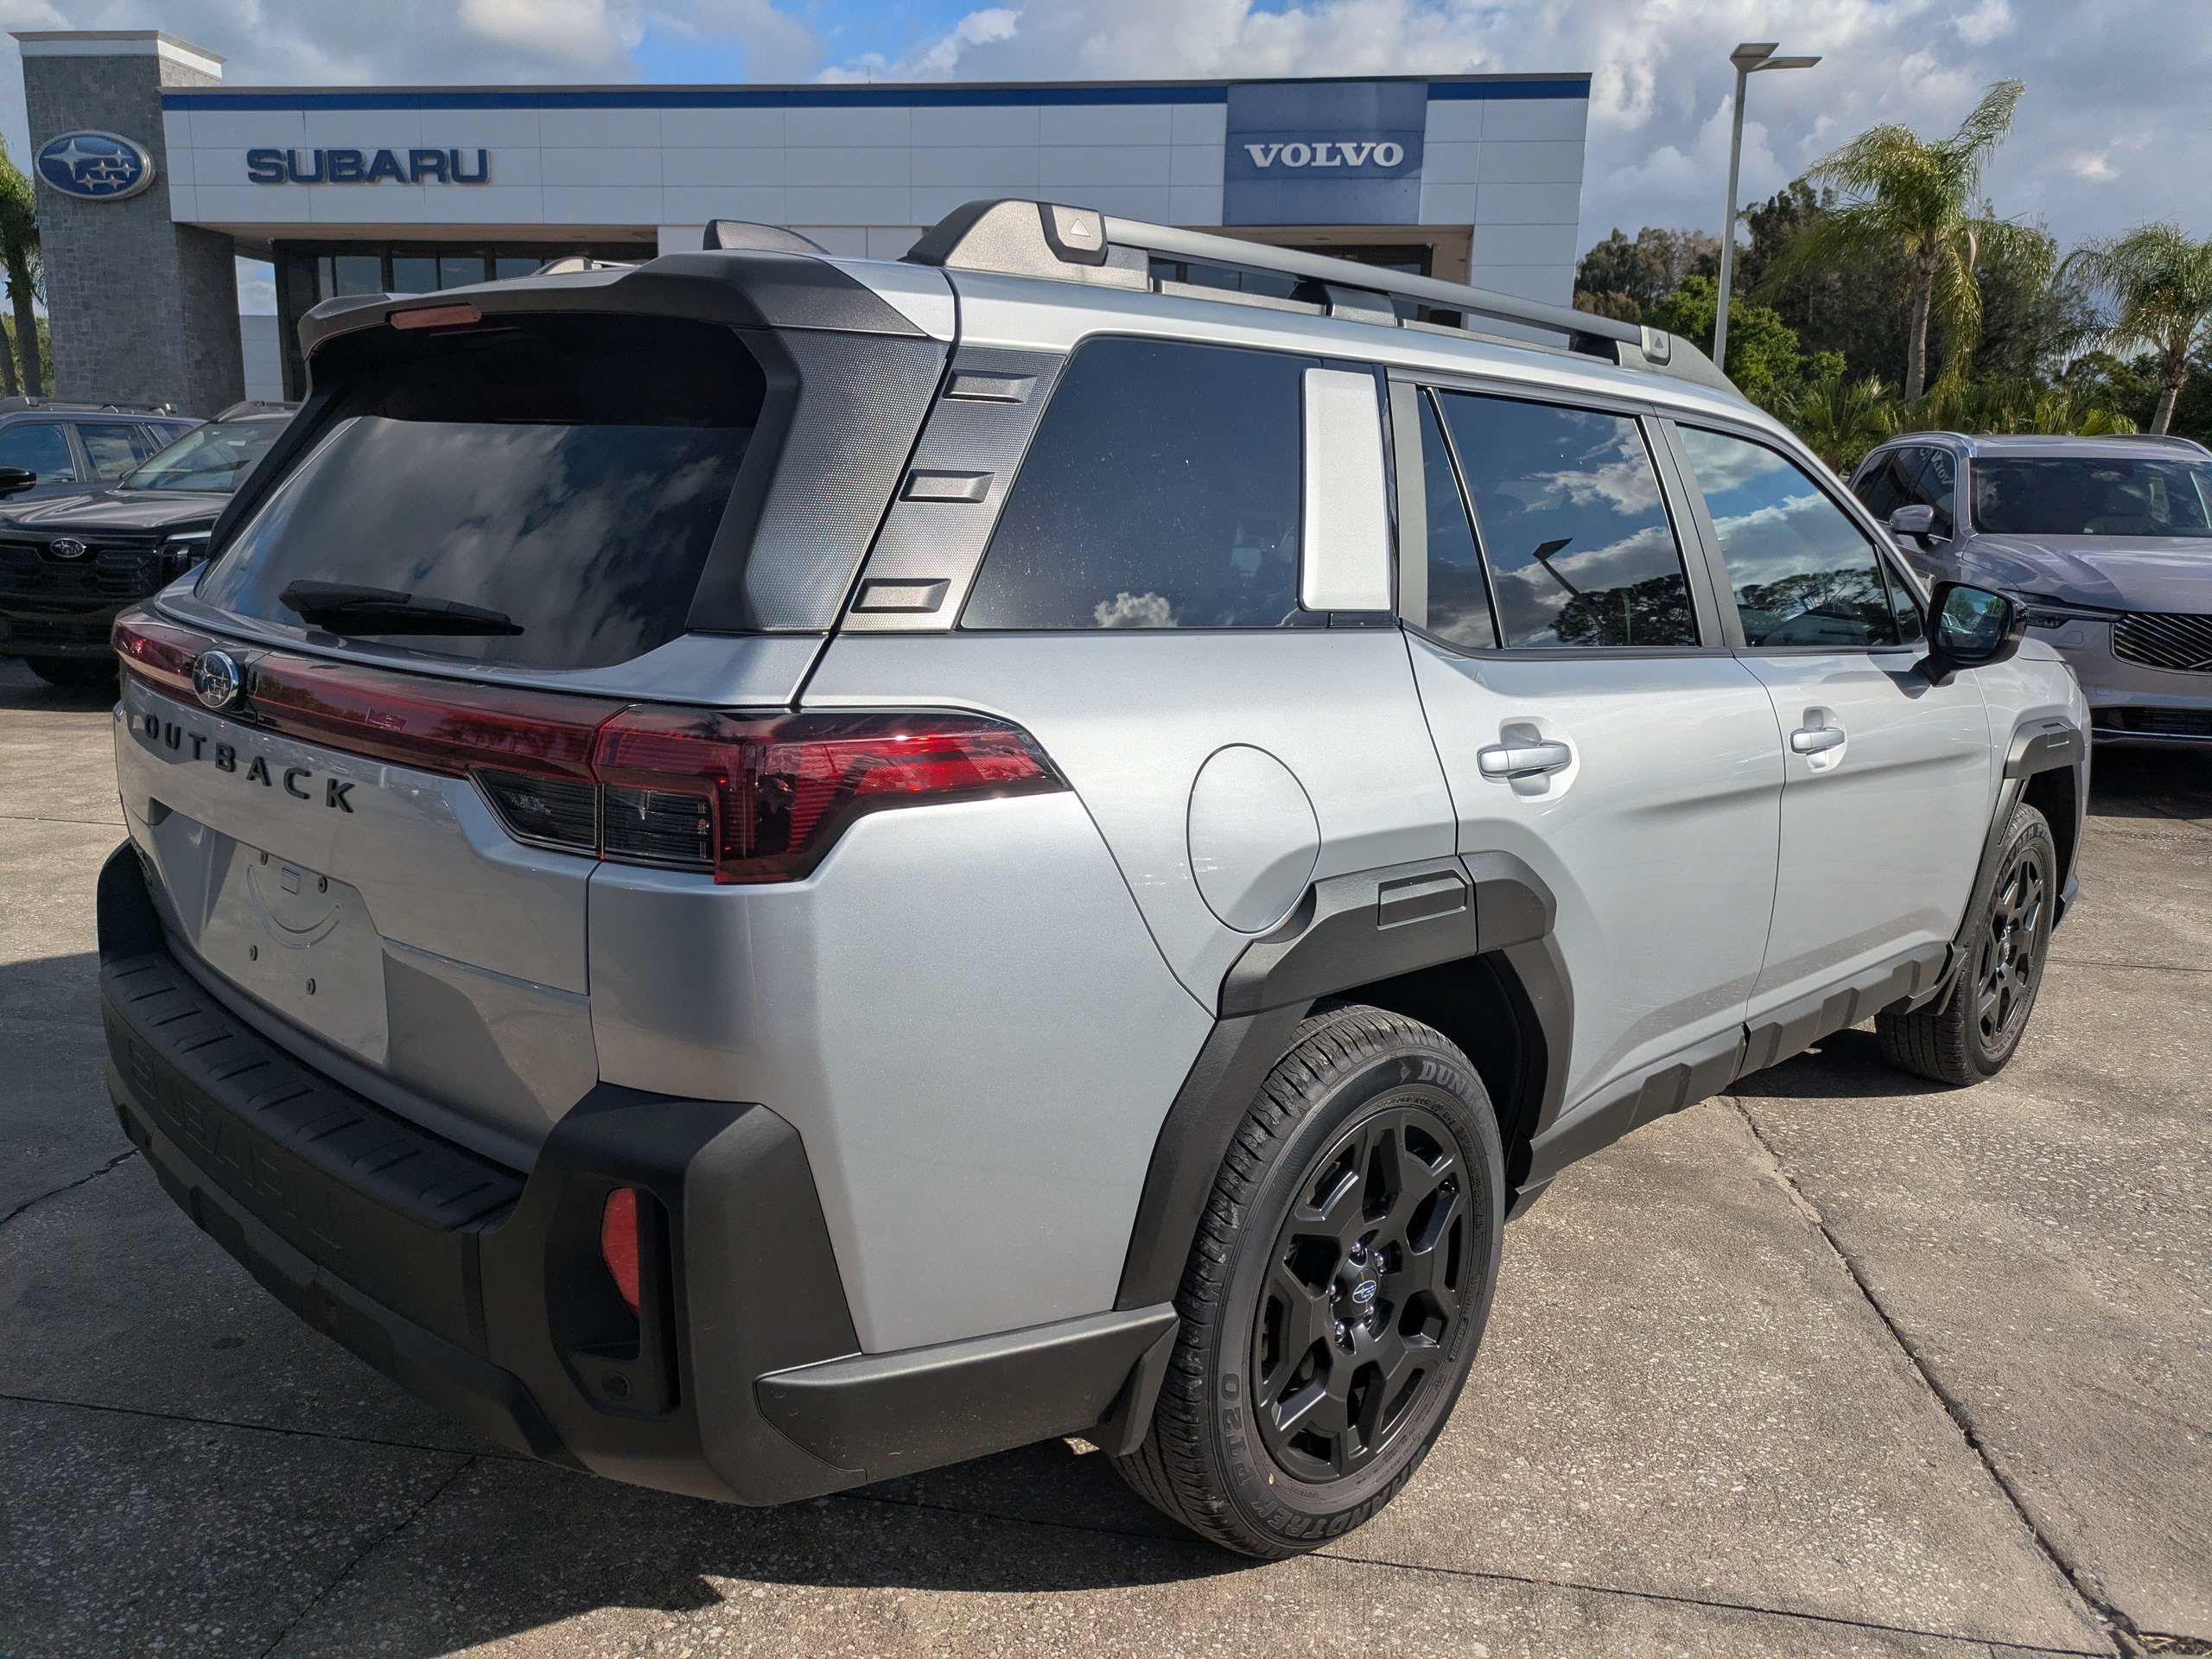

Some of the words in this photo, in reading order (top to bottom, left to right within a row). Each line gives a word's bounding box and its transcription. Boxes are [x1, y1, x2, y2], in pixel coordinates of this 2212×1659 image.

[247, 149, 490, 185] SUBARU
[1244, 143, 1404, 168] VOLVO
[144, 715, 355, 813] OUTBACK
